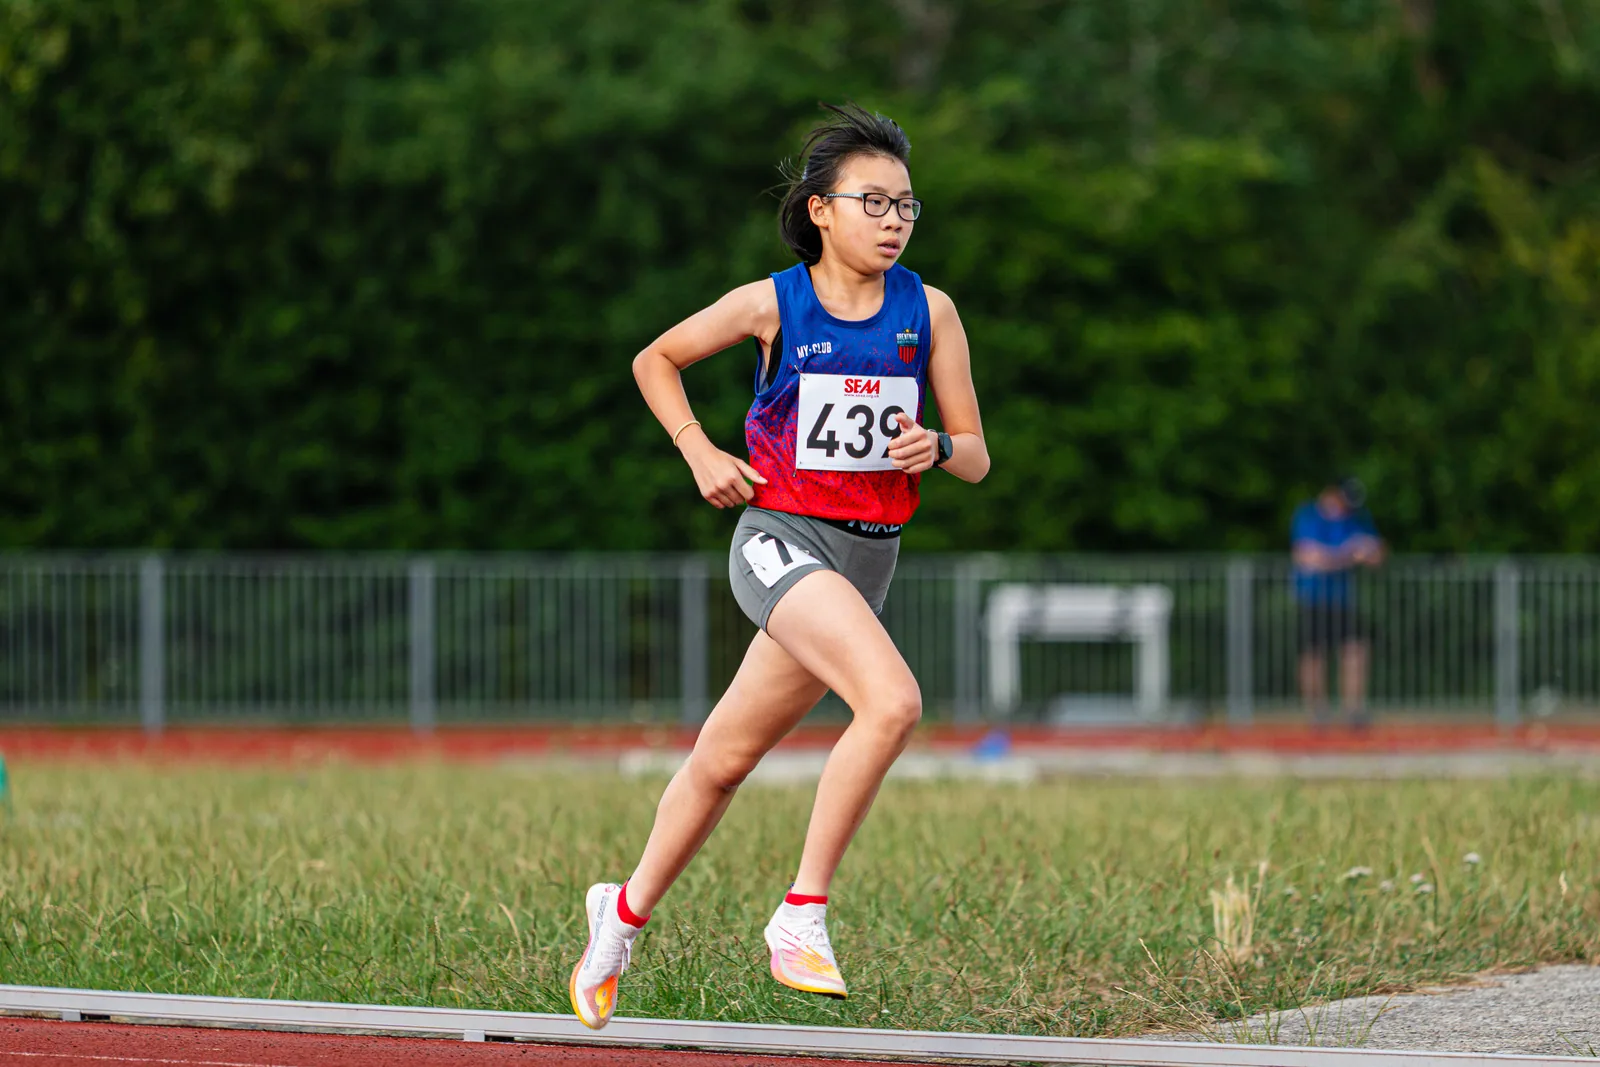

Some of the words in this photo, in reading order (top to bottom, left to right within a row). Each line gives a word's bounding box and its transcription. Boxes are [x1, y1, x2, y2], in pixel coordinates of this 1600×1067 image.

[844, 378, 881, 394] SEAA
[806, 403, 906, 459] 439
[758, 533, 794, 567] 7
